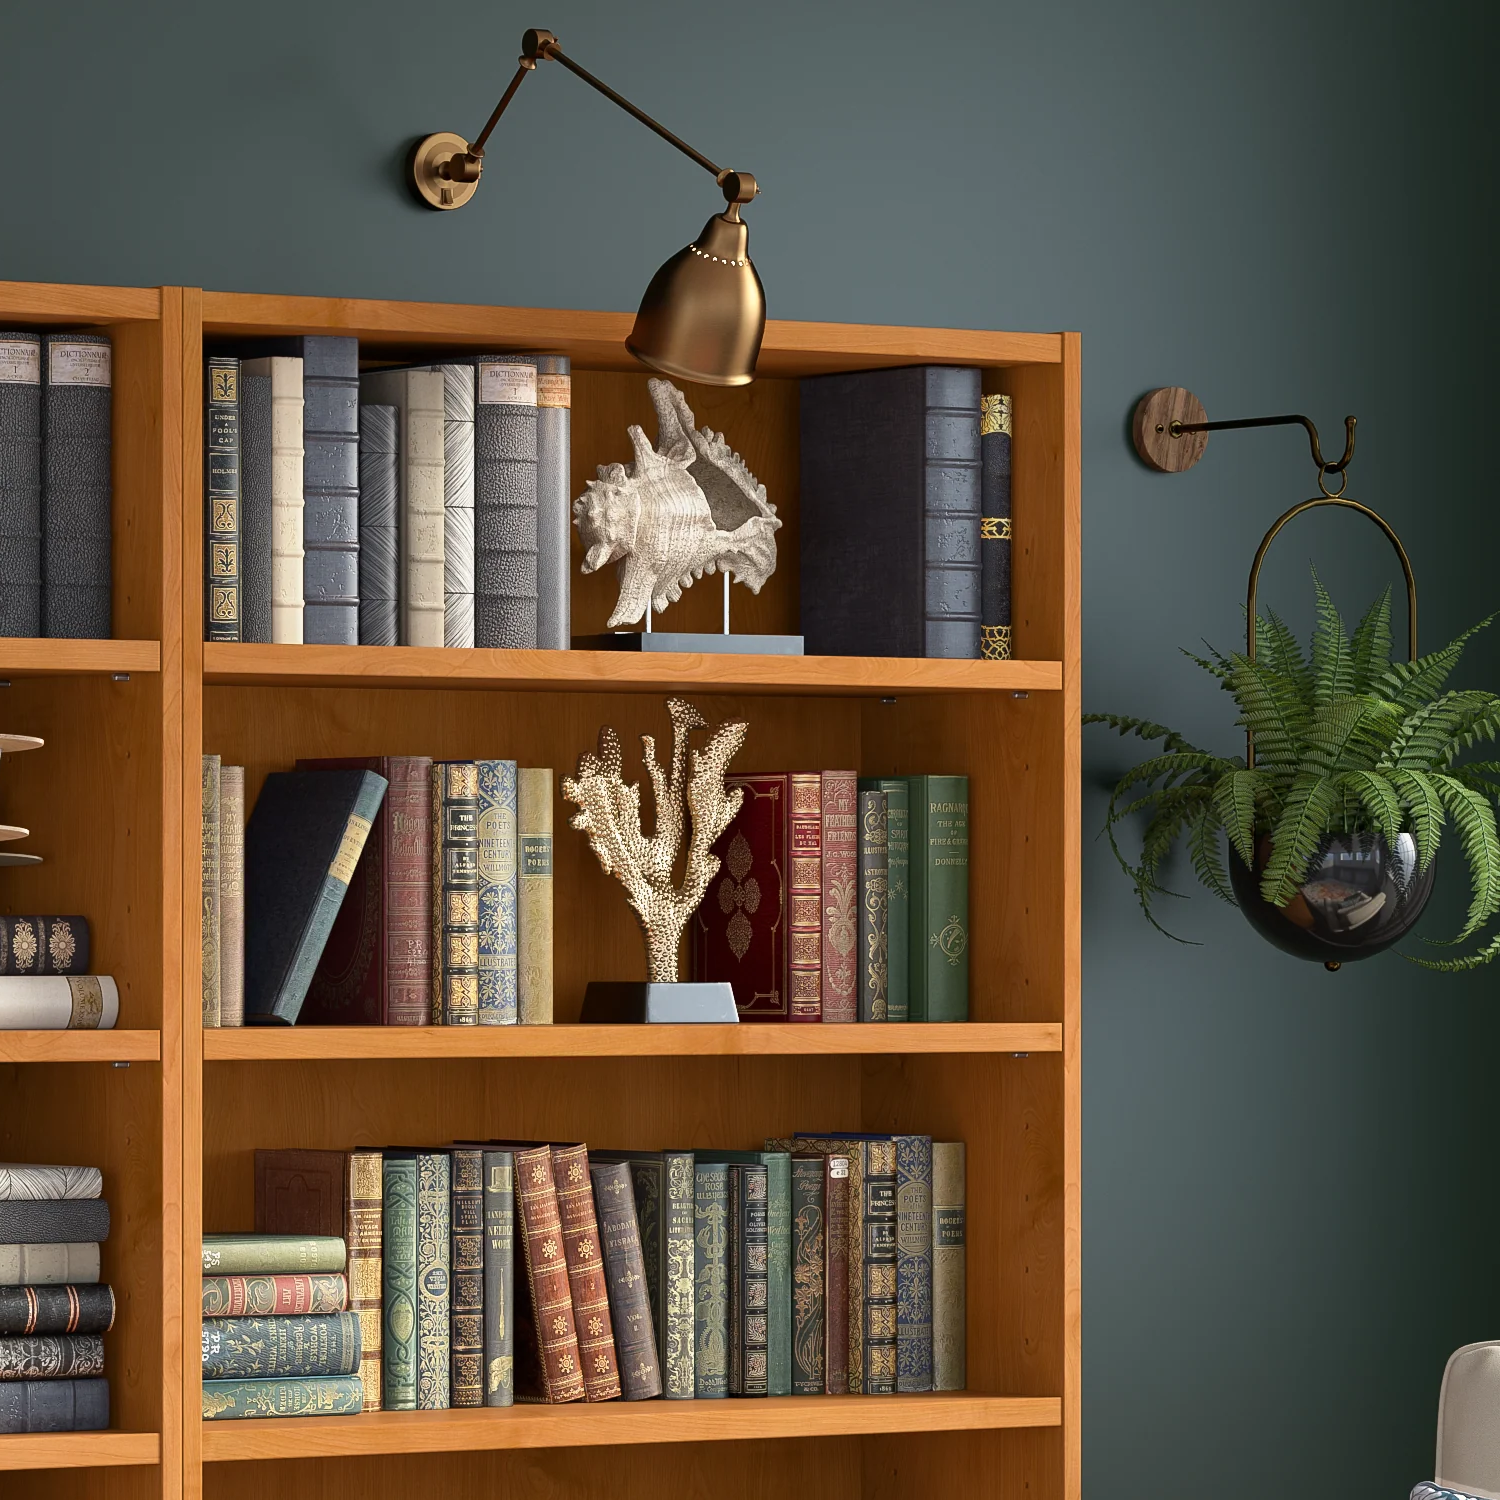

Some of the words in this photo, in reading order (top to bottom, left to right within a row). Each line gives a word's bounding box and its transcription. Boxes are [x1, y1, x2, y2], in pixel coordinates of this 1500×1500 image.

[486, 821, 511, 830] POETS
[903, 1194, 927, 1203] POETS
[282, 1288, 291, 1305] ART
[210, 1331, 221, 1355] PR
[279, 1328, 287, 1362] HENRY
[309, 1325, 318, 1362] WORKS
